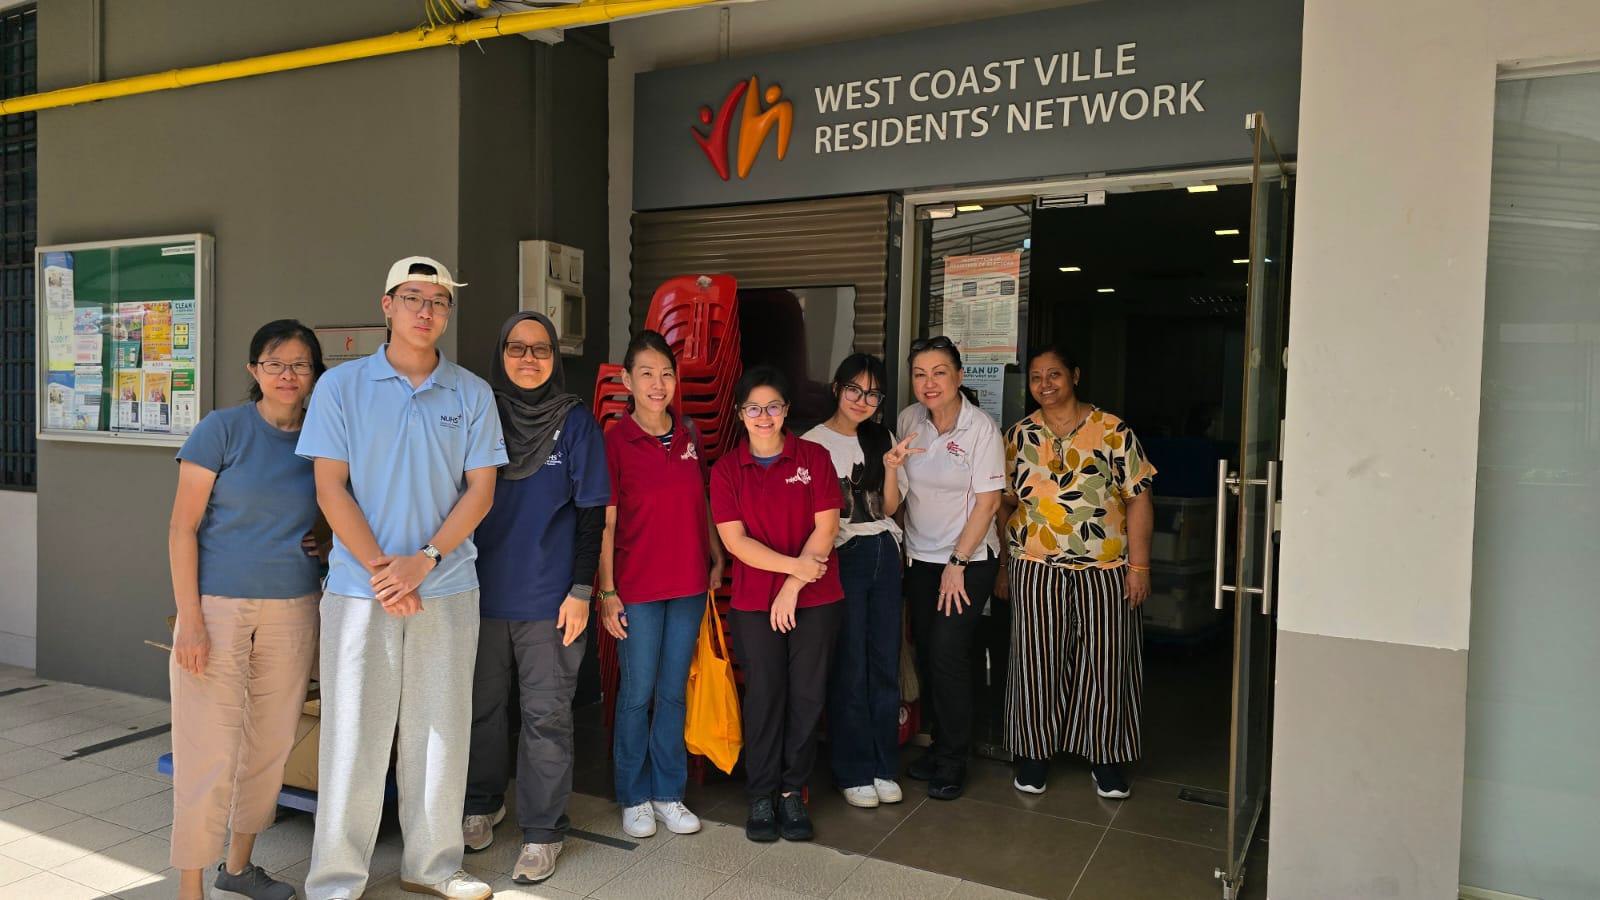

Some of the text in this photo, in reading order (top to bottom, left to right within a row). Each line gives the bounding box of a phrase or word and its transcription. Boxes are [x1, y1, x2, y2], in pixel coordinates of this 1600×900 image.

[814, 42, 1137, 114] WEST COAST VILLE
[1006, 80, 1206, 134] NETWORK
[963, 366, 999, 374] LEAN UP
[440, 415, 458, 424] NUHS
